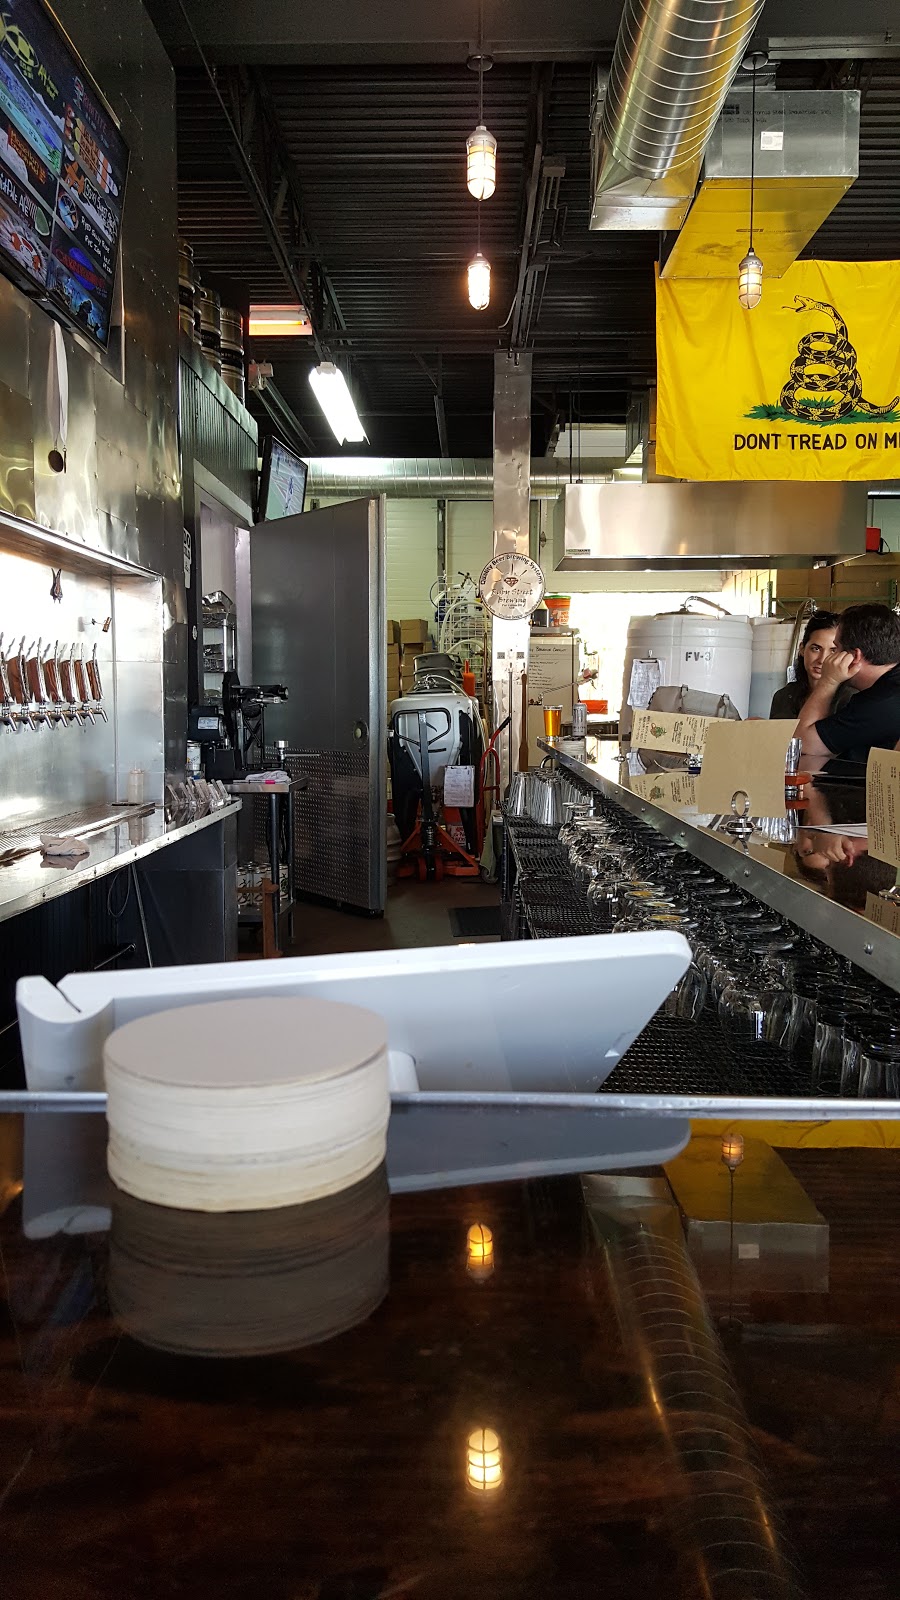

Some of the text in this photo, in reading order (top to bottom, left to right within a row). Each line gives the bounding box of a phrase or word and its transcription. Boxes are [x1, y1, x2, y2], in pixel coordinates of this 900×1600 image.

[734, 432, 900, 450] DONT TREAD ON M
[480, 554, 544, 585] Quality Beer Brewing Systems
[511, 588, 534, 596] Street
[497, 596, 527, 608] Brewing
[685, 651, 712, 662] FV-3
